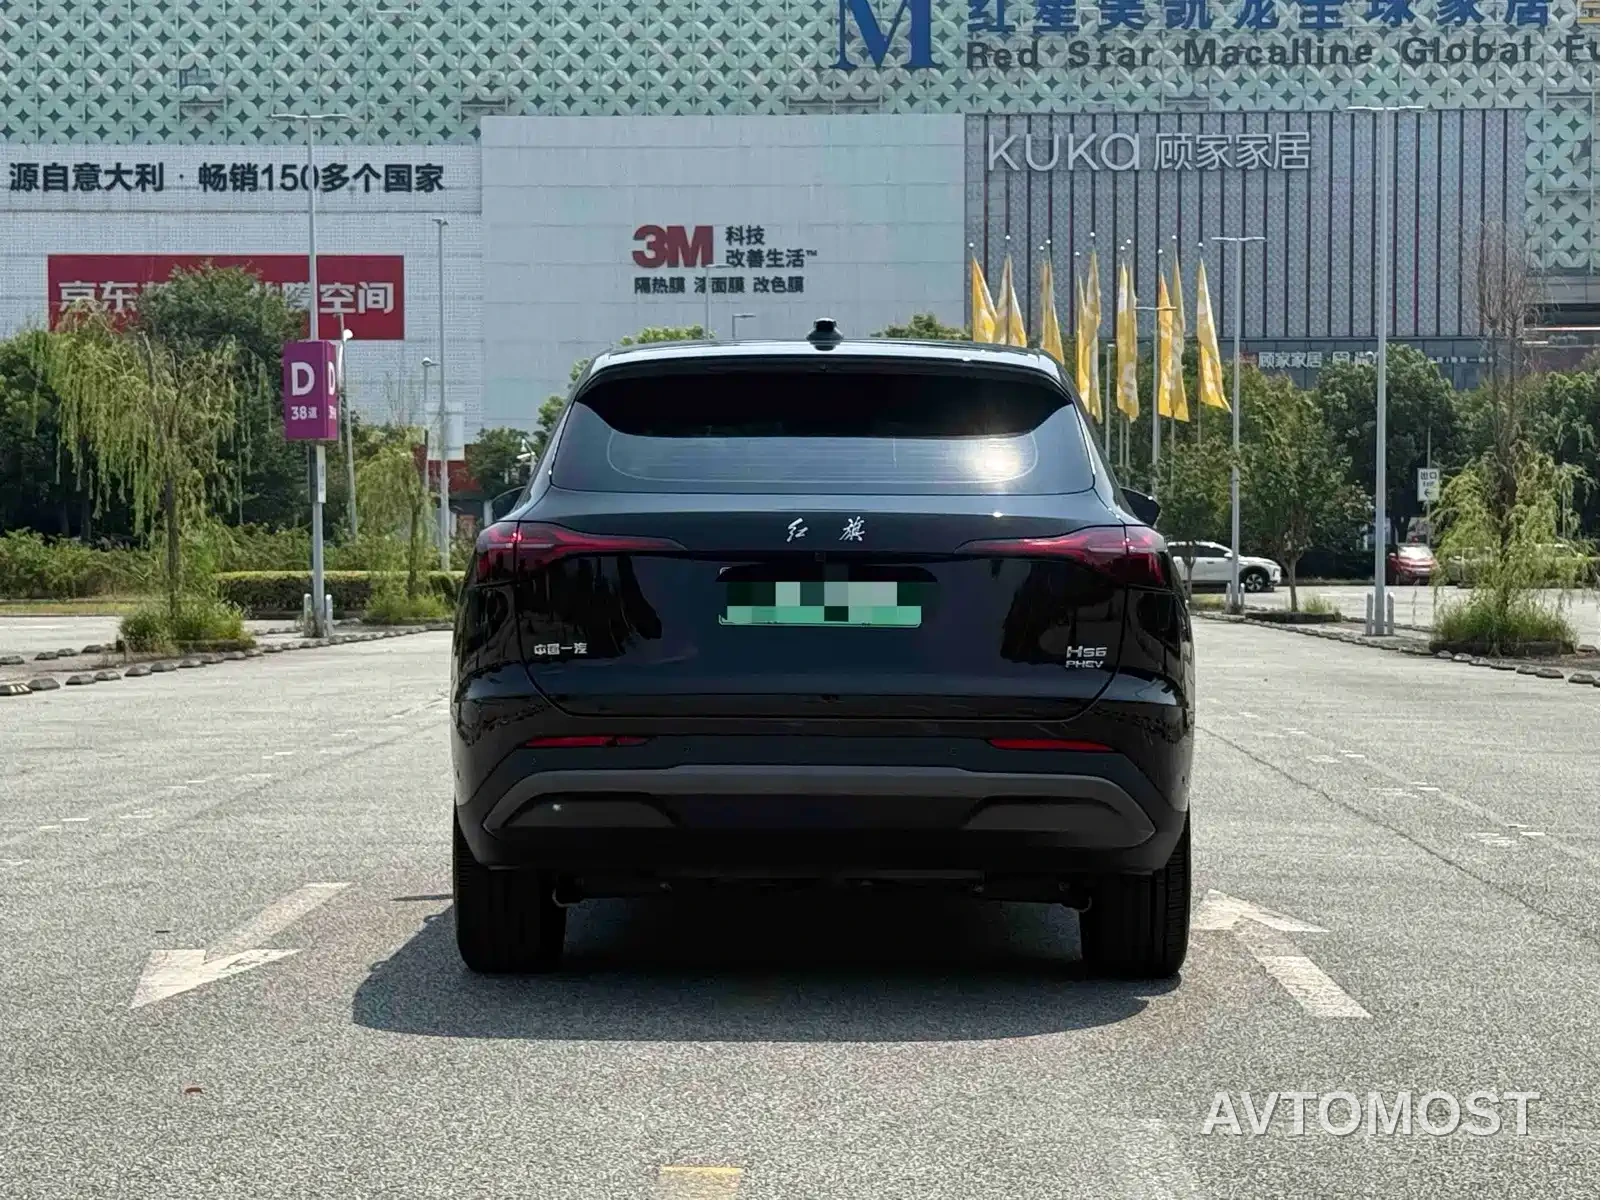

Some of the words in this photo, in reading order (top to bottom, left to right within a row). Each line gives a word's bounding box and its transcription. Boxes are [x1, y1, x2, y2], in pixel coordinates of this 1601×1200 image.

[967, 40, 1038, 68] Red
[1067, 40, 1152, 68] Star
[1184, 38, 1373, 66] Macalline
[1401, 35, 1531, 65] Global
[1154, 131, 1312, 171] 顾家家居
[9, 162, 164, 192] 源自意大利
[198, 162, 445, 193] 畅销150多个国家
[632, 224, 714, 269] 3M
[725, 225, 765, 246] 科技
[634, 276, 685, 294] 隔热膜
[753, 276, 804, 294] 改色膜
[1258, 350, 1322, 369] 顾家家居
[291, 361, 315, 396] D
[534, 642, 588, 655] 中国一汽
[1065, 660, 1104, 668] PHEV
